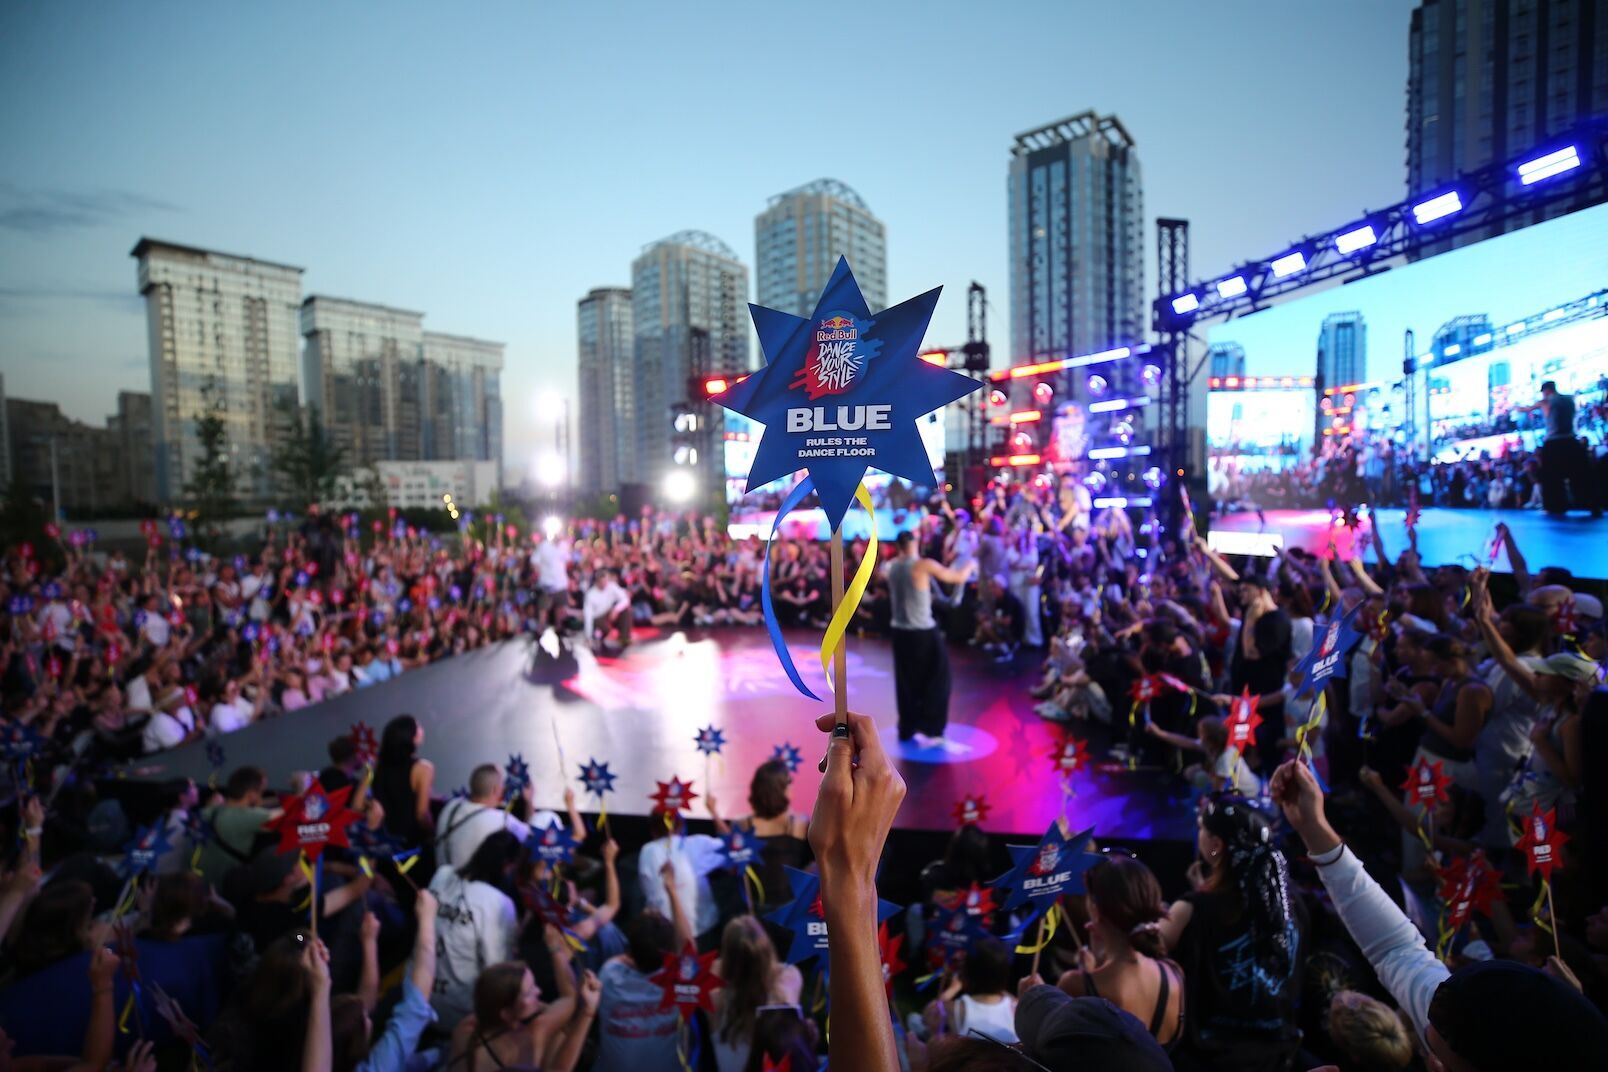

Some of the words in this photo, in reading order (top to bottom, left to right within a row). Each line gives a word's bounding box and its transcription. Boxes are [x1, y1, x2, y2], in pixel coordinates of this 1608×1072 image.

[817, 330, 837, 341] Red
[837, 329, 857, 340] Bull
[817, 341, 857, 361] DANCE
[820, 353, 859, 372] YOUR
[817, 365, 857, 390] STYLE
[787, 405, 891, 432] BLUE
[806, 438, 842, 446] RULES
[844, 437, 867, 445] THE
[798, 449, 835, 457] DANCE
[836, 448, 876, 456] FLOOR
[1311, 650, 1340, 675] BLUE
[297, 823, 331, 835] RED
[1533, 844, 1552, 855] RED
[1023, 870, 1072, 890] BLUE
[674, 984, 700, 995] RED
